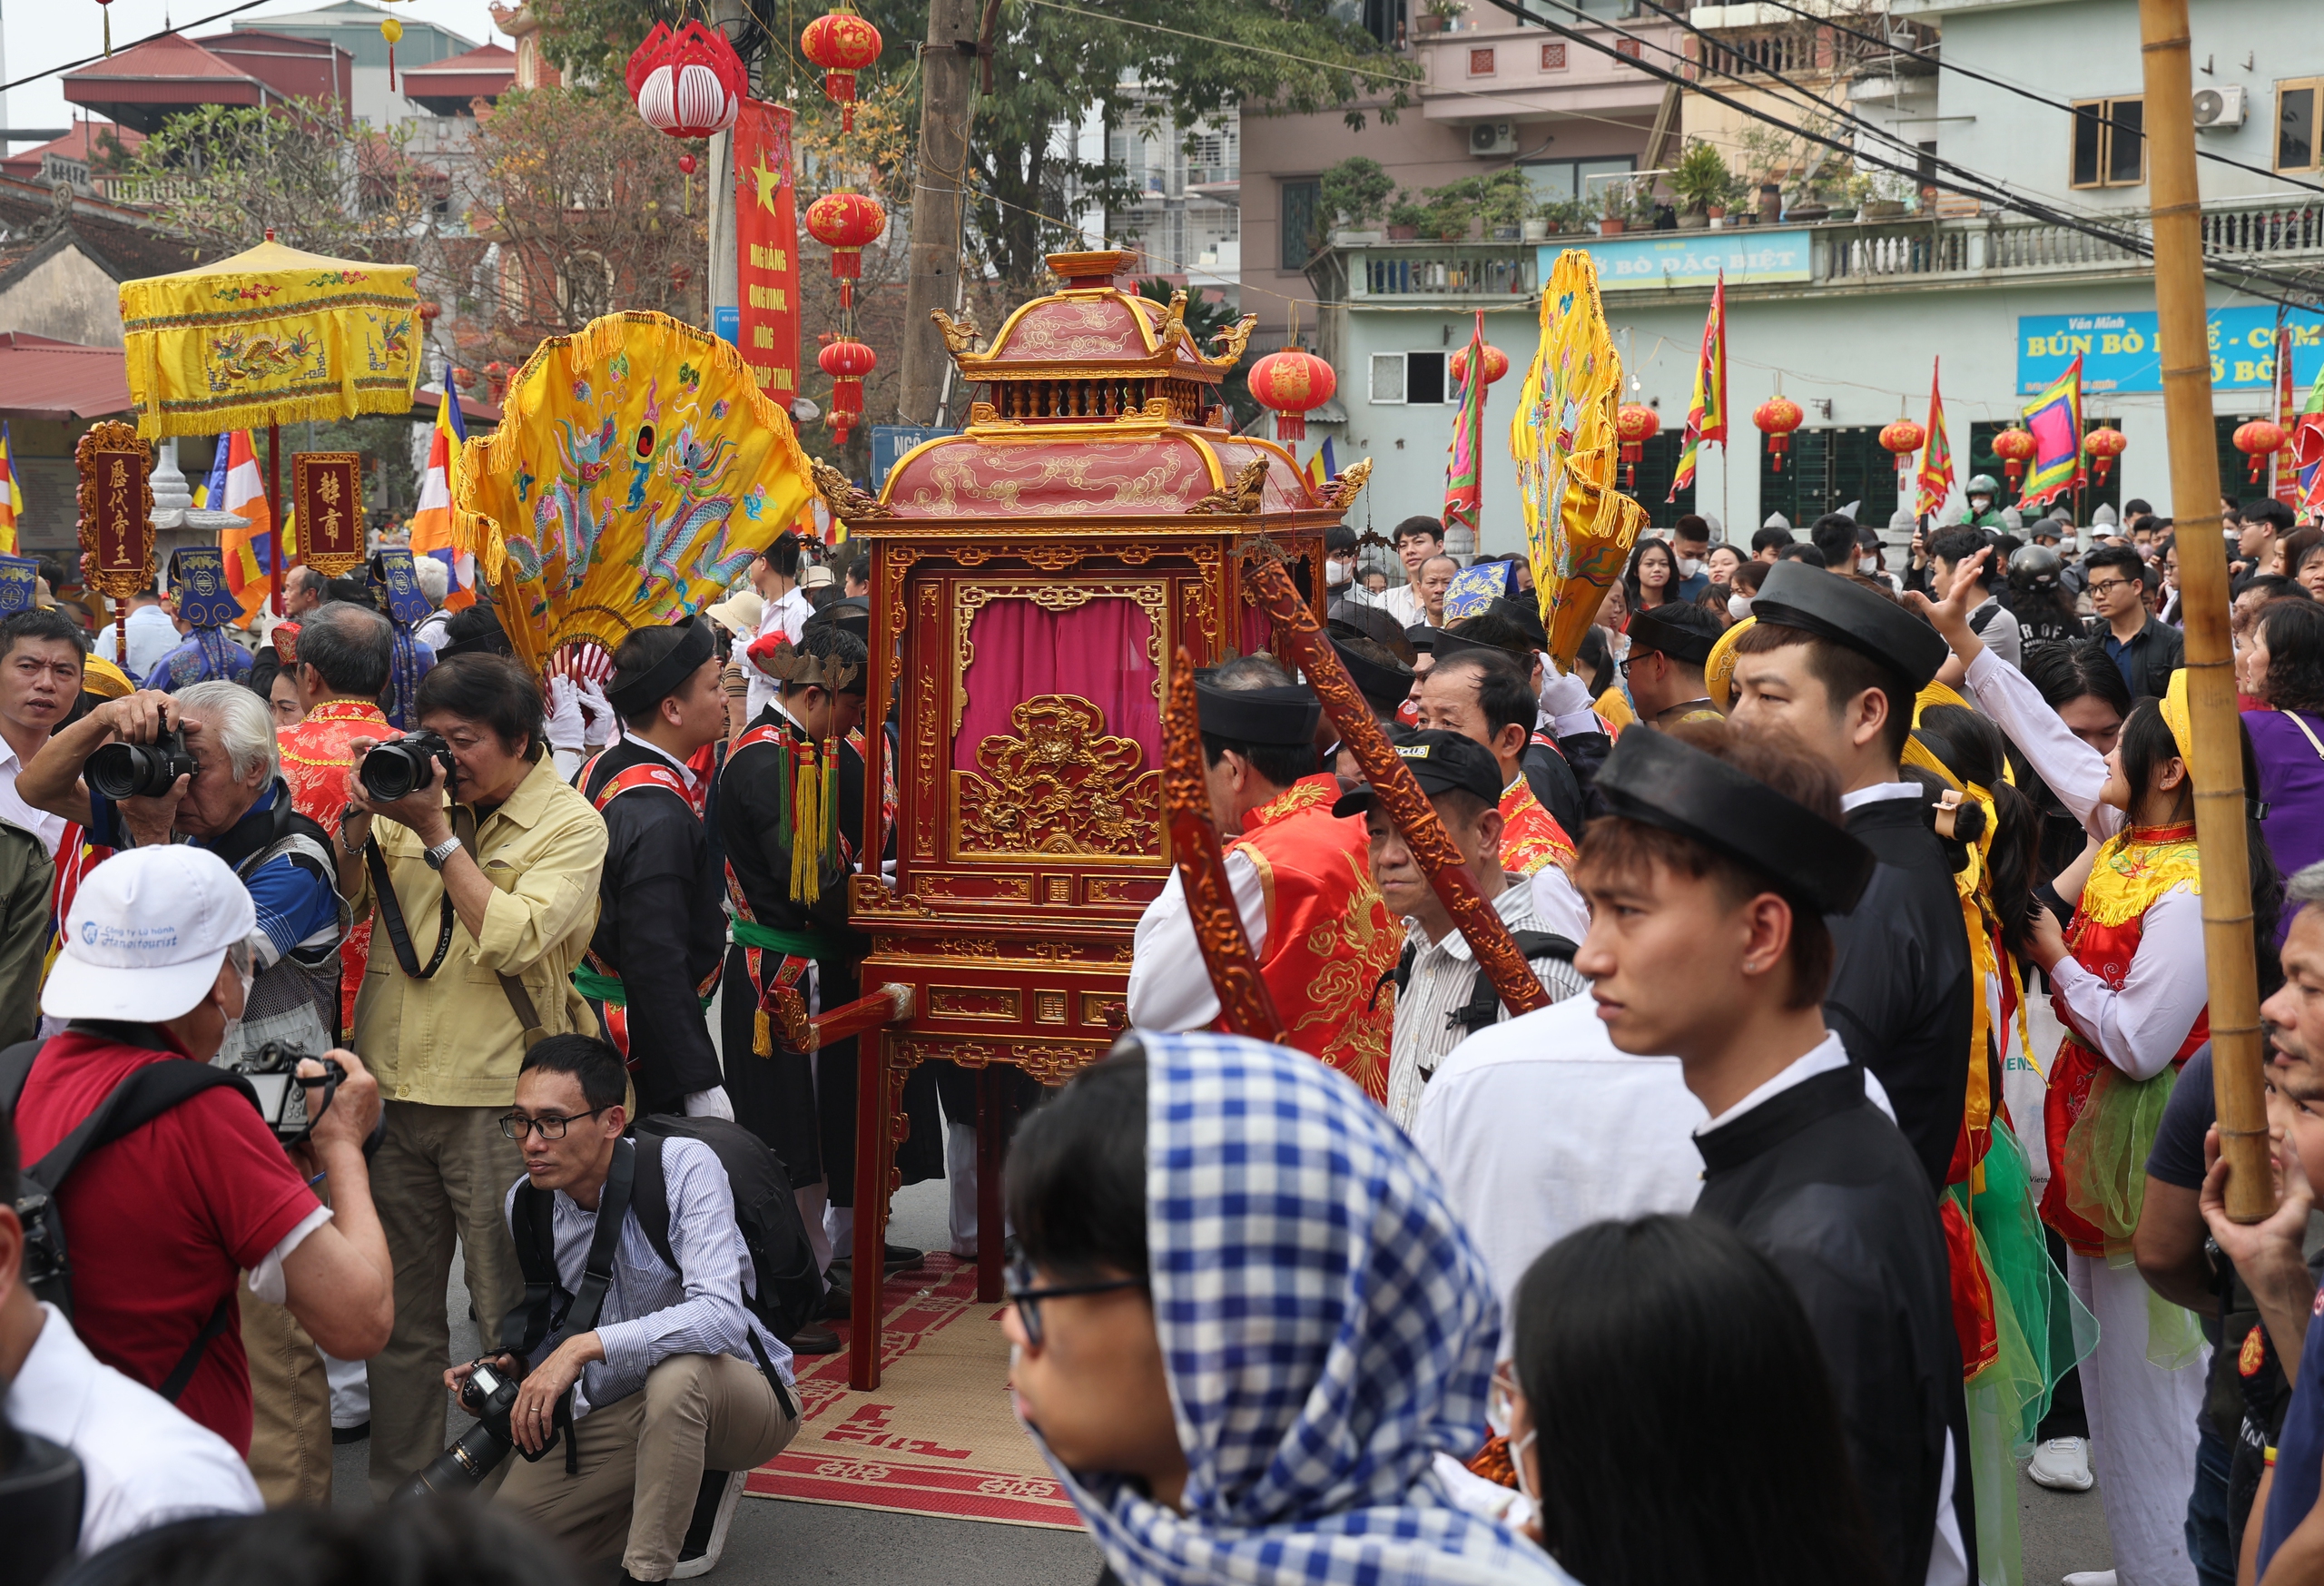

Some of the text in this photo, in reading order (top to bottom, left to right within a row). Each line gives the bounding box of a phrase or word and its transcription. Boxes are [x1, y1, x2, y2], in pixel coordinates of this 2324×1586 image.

[750, 243, 764, 268] MG
[1615, 255, 1652, 275] BÒ
[1660, 252, 1721, 275] ĐẶC
[1728, 248, 1796, 271] BIỆT
[2026, 330, 2093, 357] BÚN
[2101, 327, 2144, 354] BÒ
[773, 363, 793, 394] THÌN,
[2233, 353, 2274, 382] BÒ
[100, 932, 178, 950] Hanoitourist
[434, 928, 450, 964] SONY
